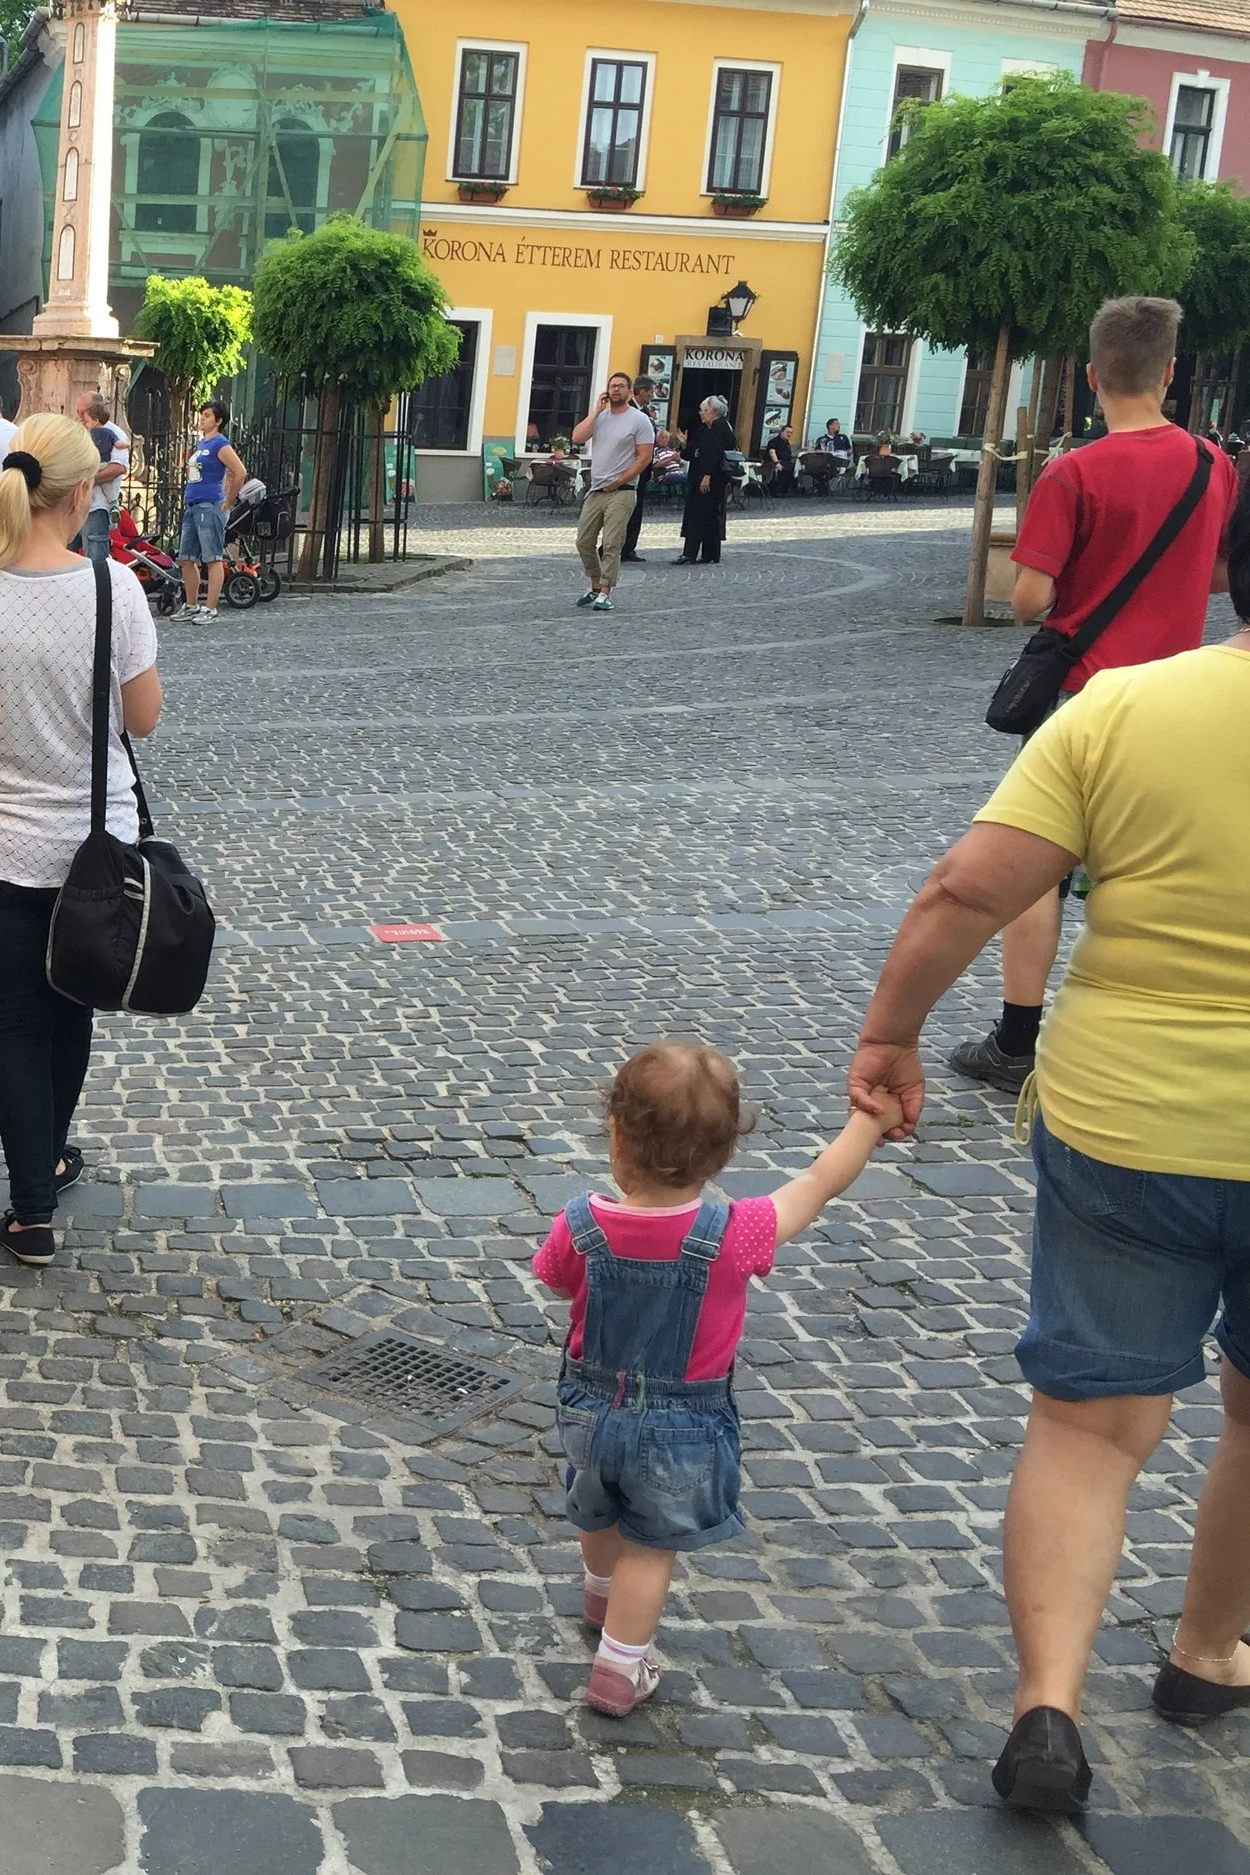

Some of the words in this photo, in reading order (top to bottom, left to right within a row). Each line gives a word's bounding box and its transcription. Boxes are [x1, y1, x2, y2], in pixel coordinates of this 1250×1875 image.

[422, 238, 506, 263] KORONA
[514, 236, 601, 269] ÉTTEREM
[609, 249, 735, 275] RESTAURANT
[685, 349, 744, 362] KORONA
